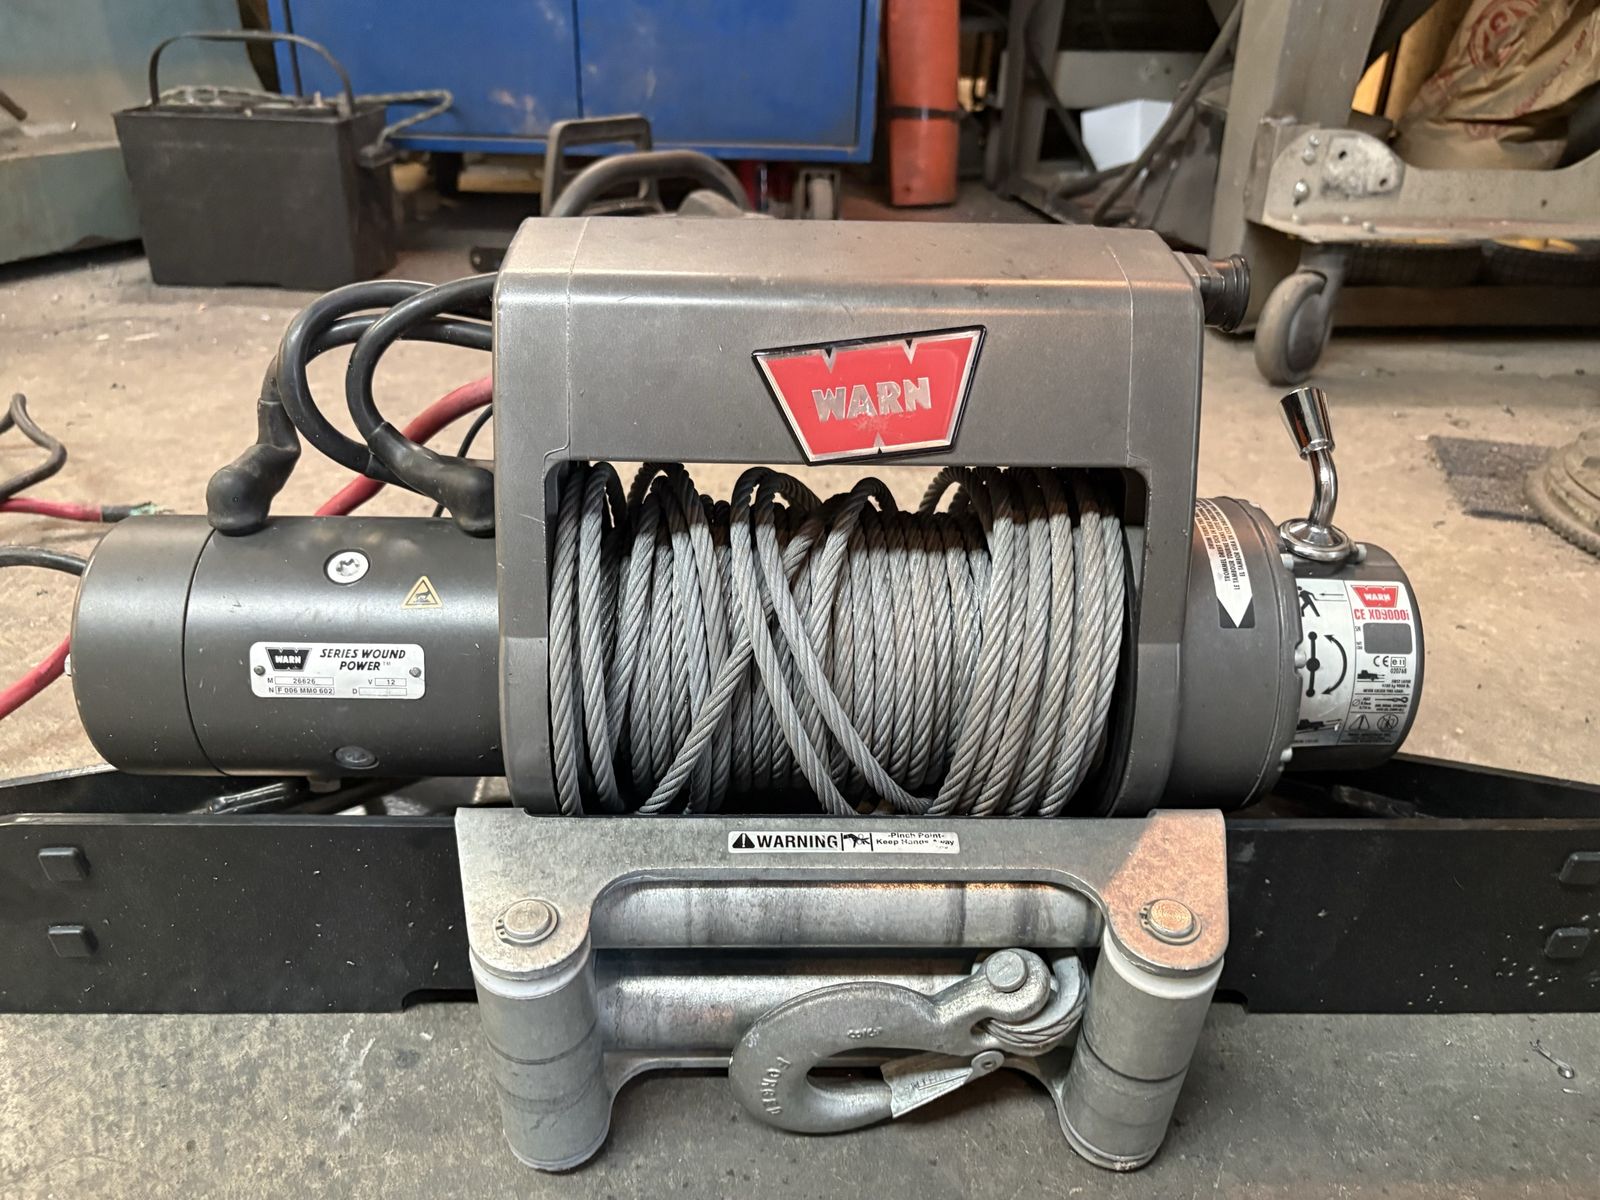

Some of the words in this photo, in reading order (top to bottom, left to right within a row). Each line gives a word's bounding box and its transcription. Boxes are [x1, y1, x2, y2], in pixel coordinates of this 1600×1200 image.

[811, 377, 932, 422] WARN
[1230, 541, 1239, 552] GIRA
[1233, 552, 1244, 571] TAMBOR
[1220, 559, 1231, 582] TROMMEL
[1229, 560, 1240, 584] TAMBOUR
[1363, 592, 1392, 602] WARN
[1353, 608, 1366, 620] CE
[1367, 608, 1410, 621] XD9000i
[274, 655, 302, 664] WARN
[319, 648, 359, 659] SERIES
[361, 649, 406, 660] WOUND
[340, 661, 381, 671] POWER
[756, 834, 838, 849] WARNING
[876, 838, 899, 846] Keep
